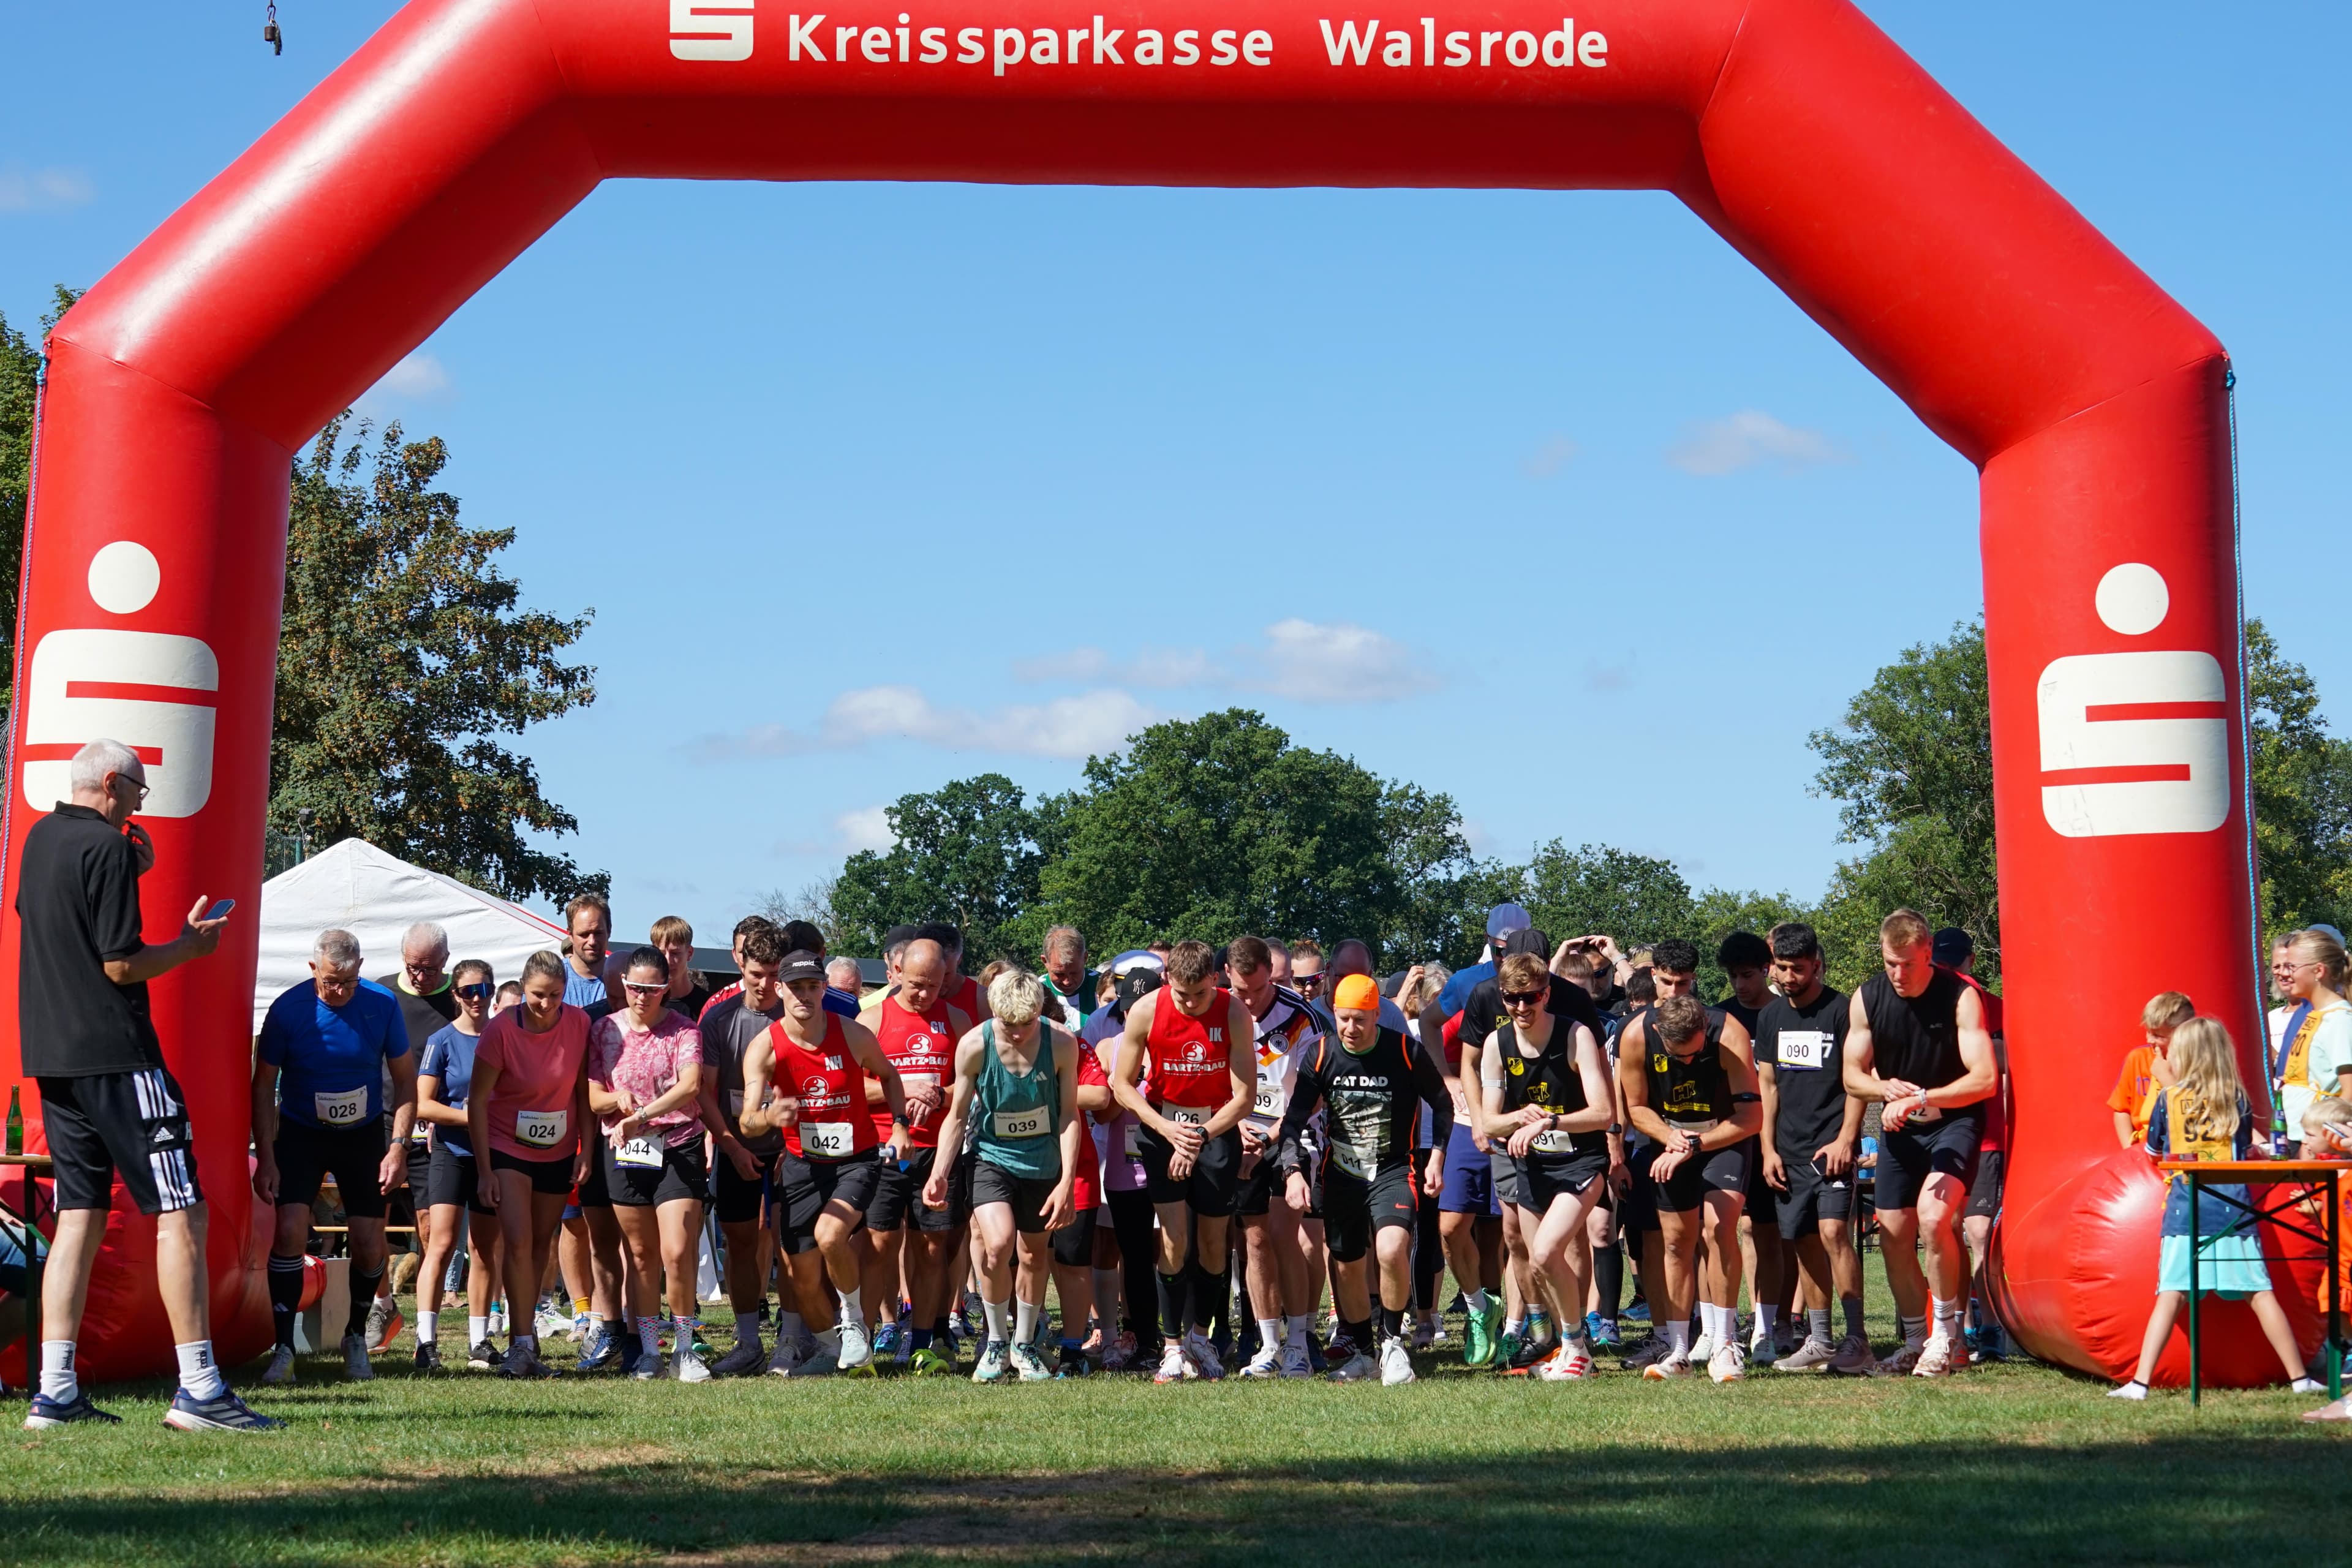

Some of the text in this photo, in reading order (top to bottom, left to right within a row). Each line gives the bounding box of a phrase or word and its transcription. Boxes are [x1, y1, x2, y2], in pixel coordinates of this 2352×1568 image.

[789, 13, 1273, 77] Kreissparkasse
[1319, 17, 1608, 67] Walsrode
[930, 1020, 947, 1034] GK
[1209, 1027, 1223, 1042] IK
[1787, 1045, 1809, 1057] 090
[824, 1055, 843, 1071] NH
[1333, 1076, 1389, 1087] CAT DAD
[1255, 1095, 1272, 1107] 09
[329, 1102, 357, 1118] 028
[529, 1125, 556, 1138] 024
[1008, 1120, 1037, 1133] 039
[625, 1142, 650, 1156] 044
[812, 1136, 840, 1149] 042
[1341, 1153, 1361, 1170] 011
